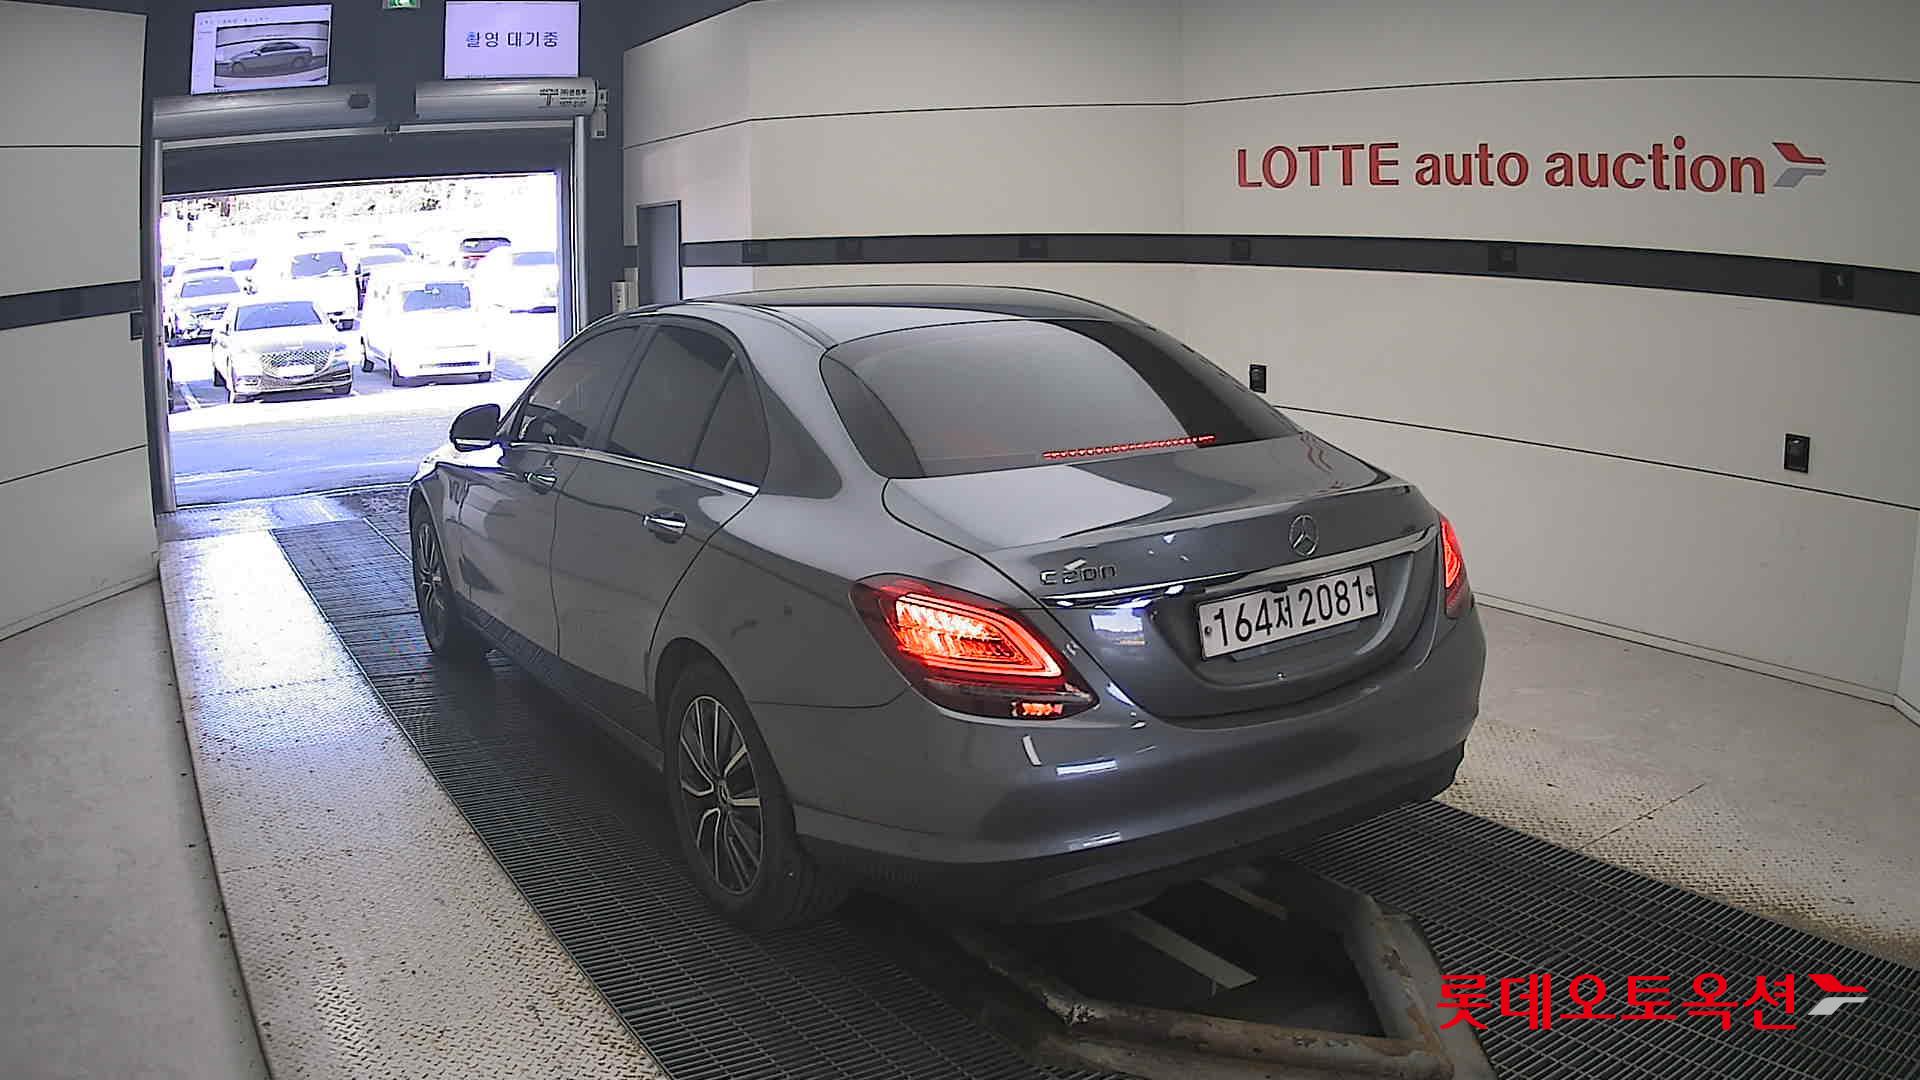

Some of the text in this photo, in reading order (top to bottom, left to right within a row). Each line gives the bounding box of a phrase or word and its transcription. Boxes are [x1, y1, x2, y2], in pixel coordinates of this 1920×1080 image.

[465, 31, 558, 48] 촬영 대기중
[1237, 135, 1766, 194] LOTTE auto auction
